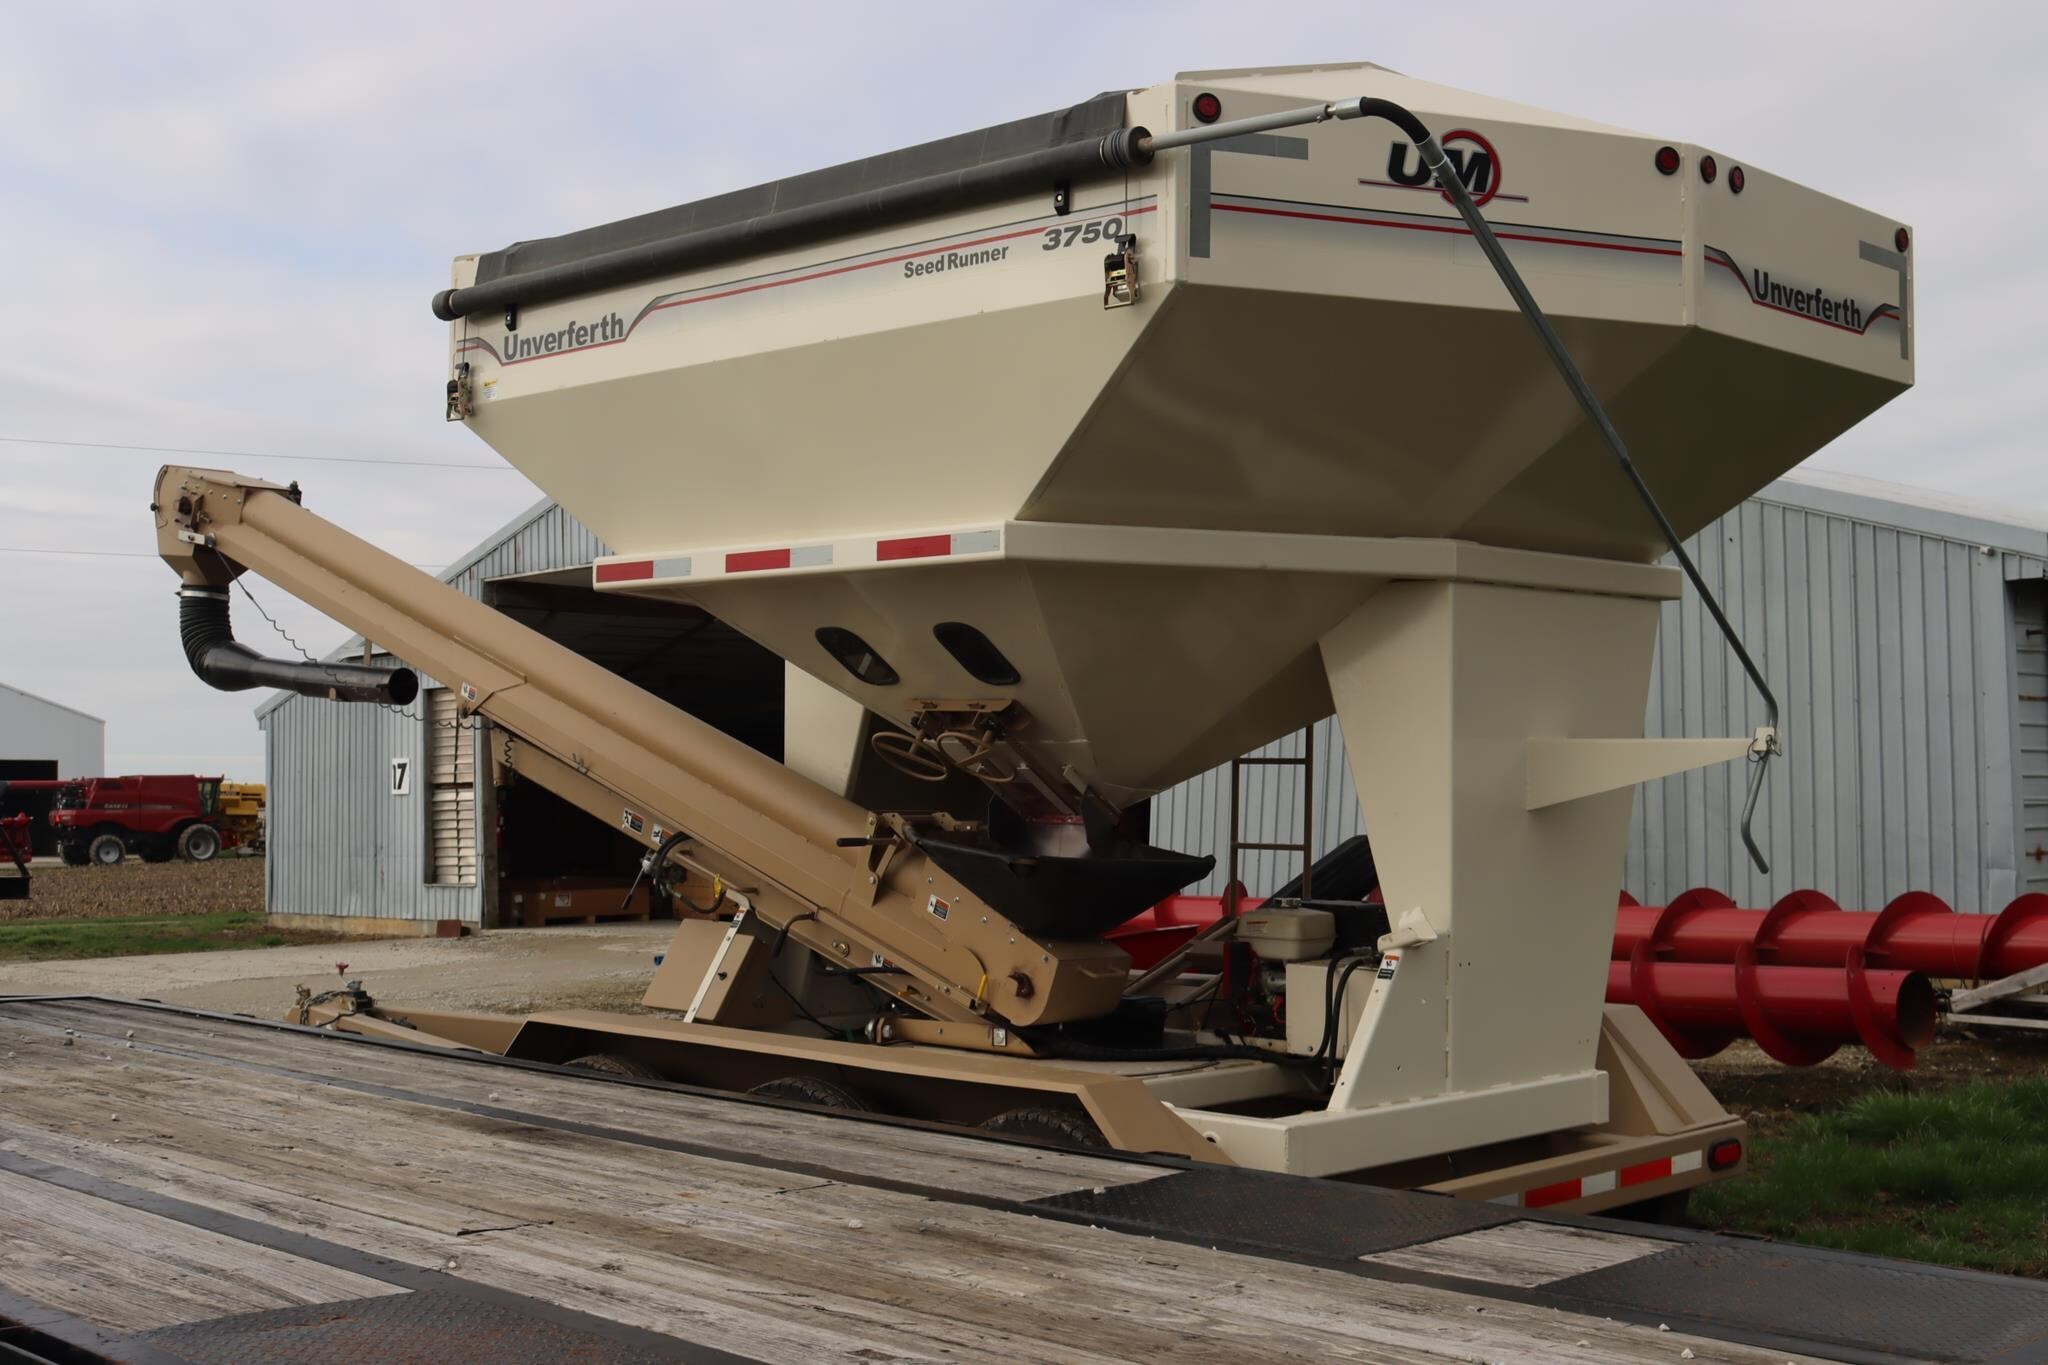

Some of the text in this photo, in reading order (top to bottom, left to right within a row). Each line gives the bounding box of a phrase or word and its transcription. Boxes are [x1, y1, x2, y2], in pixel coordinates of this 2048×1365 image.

[1042, 217, 1123, 251] 3750
[904, 246, 1009, 278] Seed Runner
[1754, 268, 1862, 329] Unverferth
[504, 312, 624, 360] Unverferth
[393, 762, 408, 790] 17
